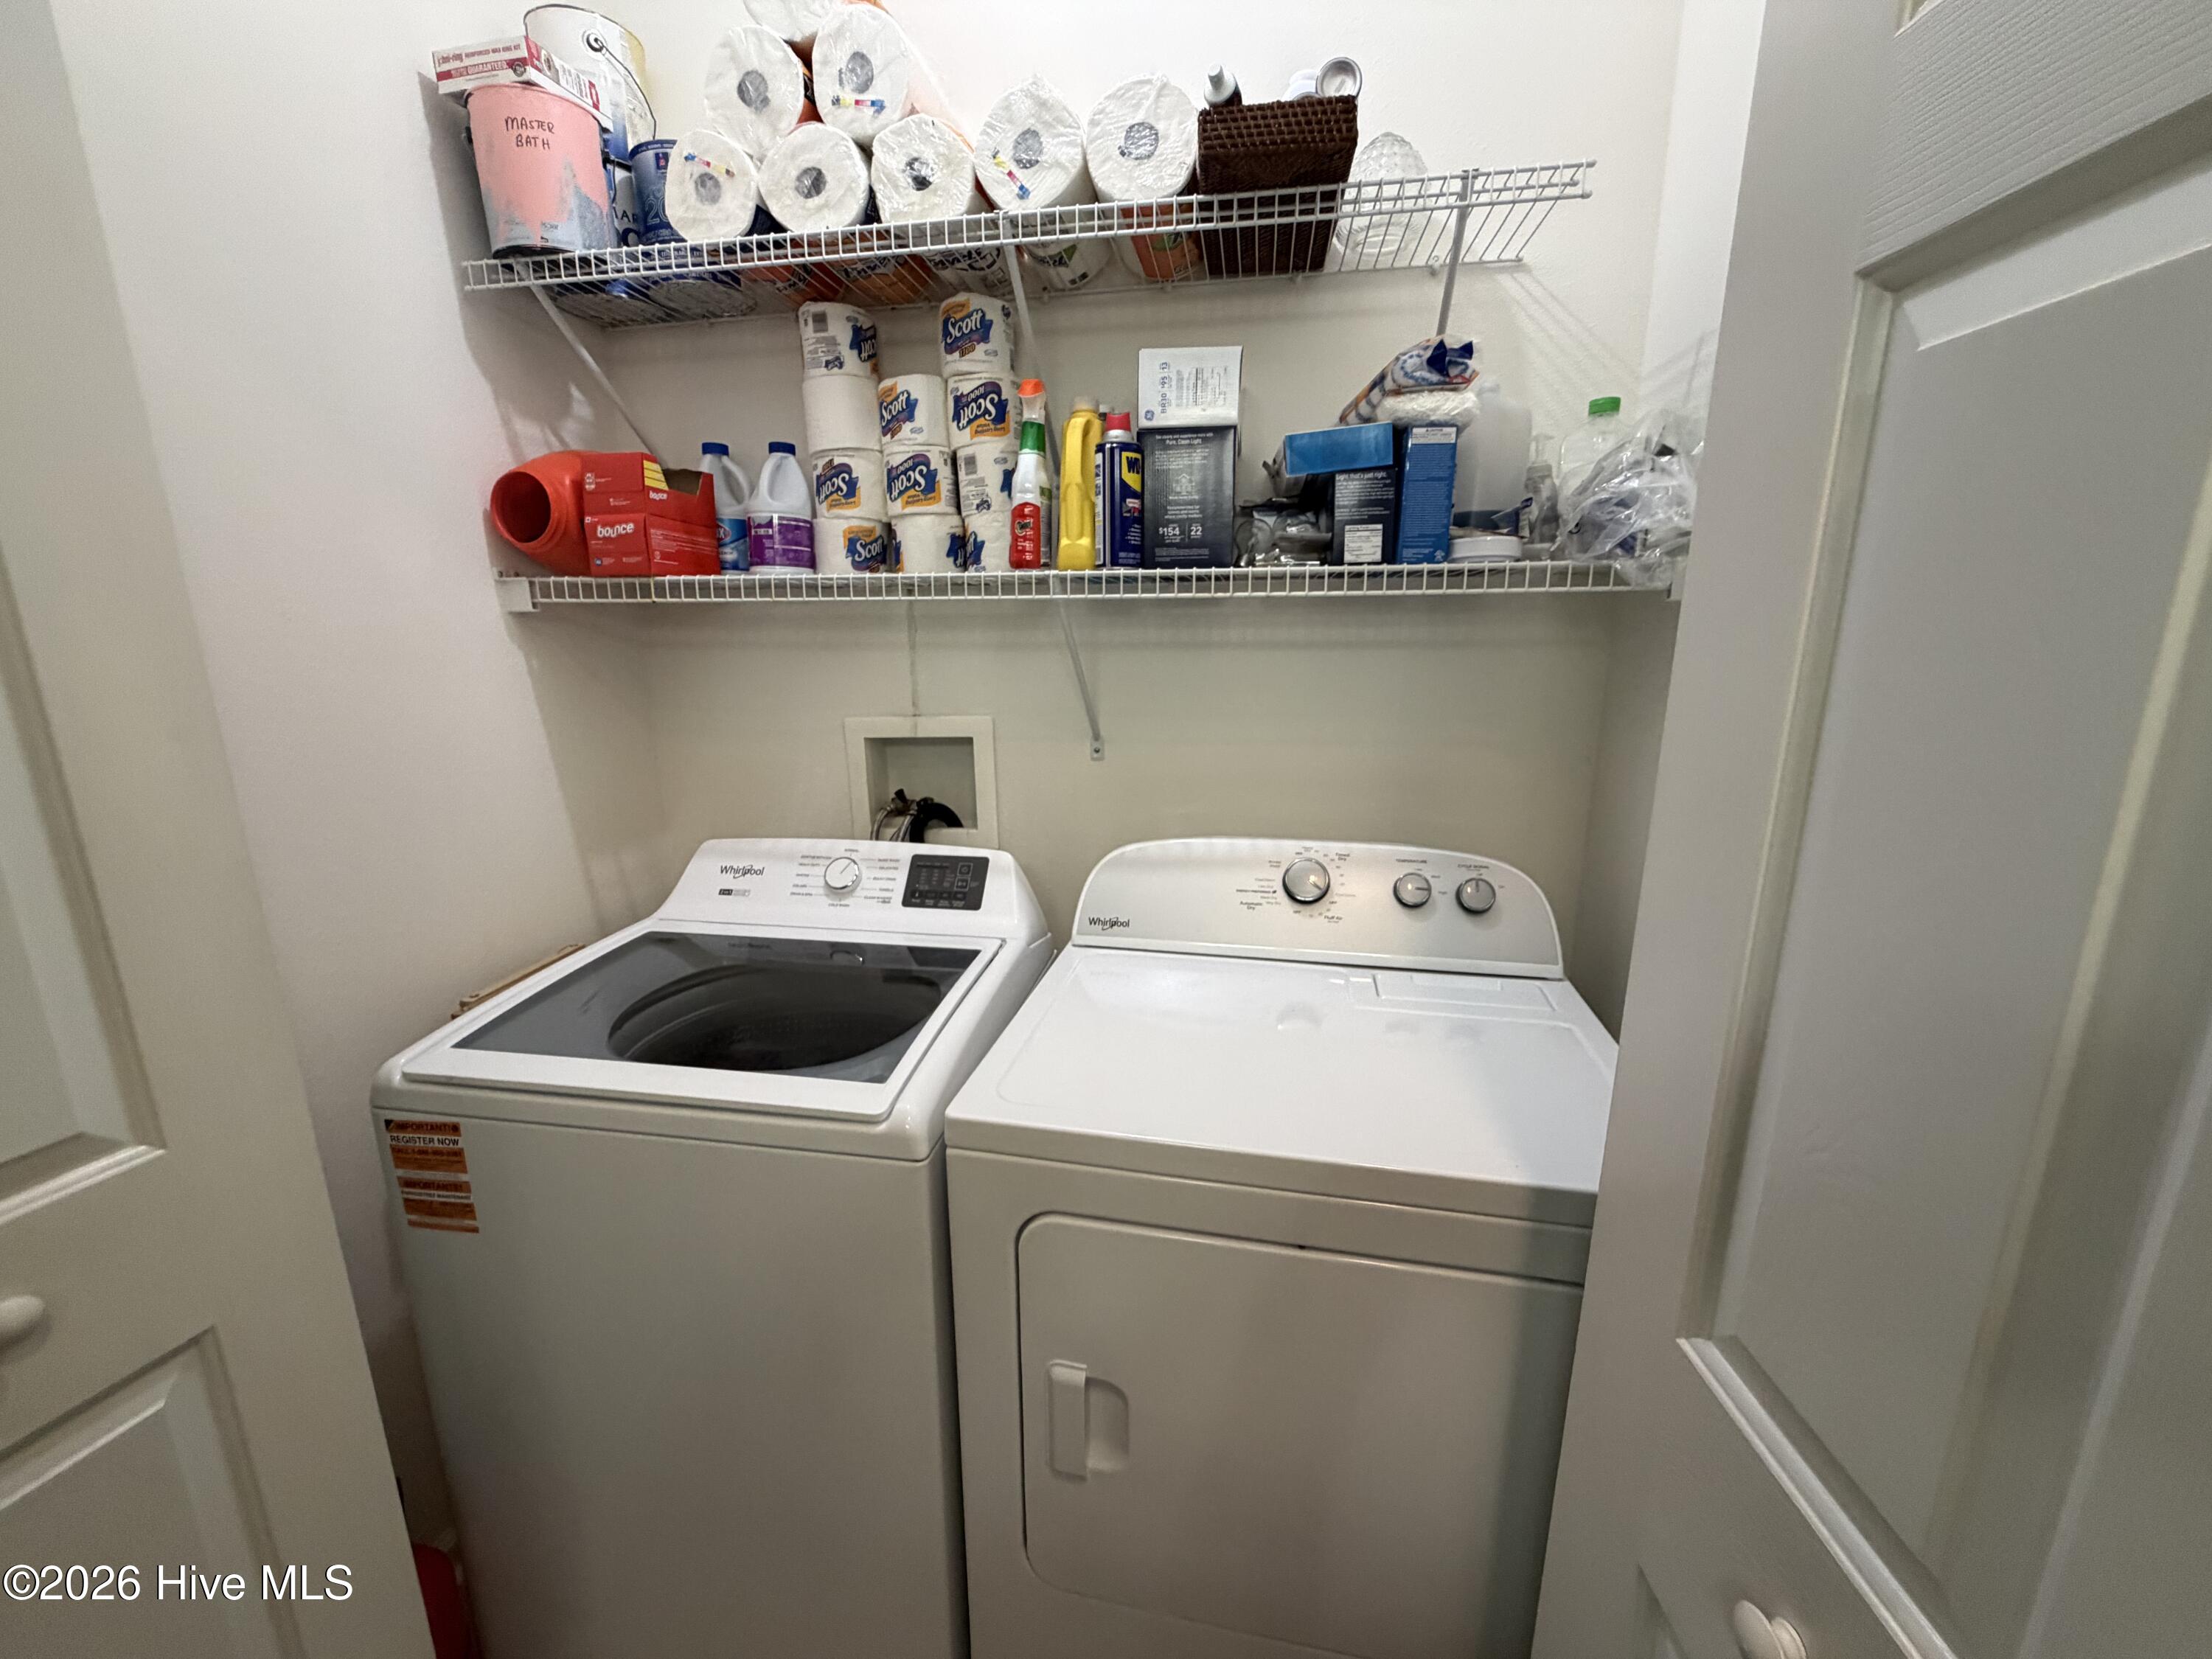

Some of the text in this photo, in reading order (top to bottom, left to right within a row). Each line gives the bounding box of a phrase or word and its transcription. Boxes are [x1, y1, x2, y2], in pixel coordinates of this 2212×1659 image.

[504, 116, 554, 134] MASTER
[515, 133, 551, 150] BATH
[946, 310, 984, 344] Scott
[967, 386, 985, 402] 1000
[881, 391, 908, 426] Scott
[959, 393, 998, 429] Scott
[897, 458, 913, 474] 1000
[819, 473, 849, 502] Scott
[891, 465, 928, 501] Scott
[650, 490, 667, 501] bounce
[597, 522, 634, 538] bounce
[1158, 526, 1203, 536] $154 22
[854, 534, 884, 562] Scott
[720, 864, 765, 879] Whirlpool
[1088, 917, 1130, 931] Whirlpool
[390, 1135, 459, 1147] REGISTER NOW
